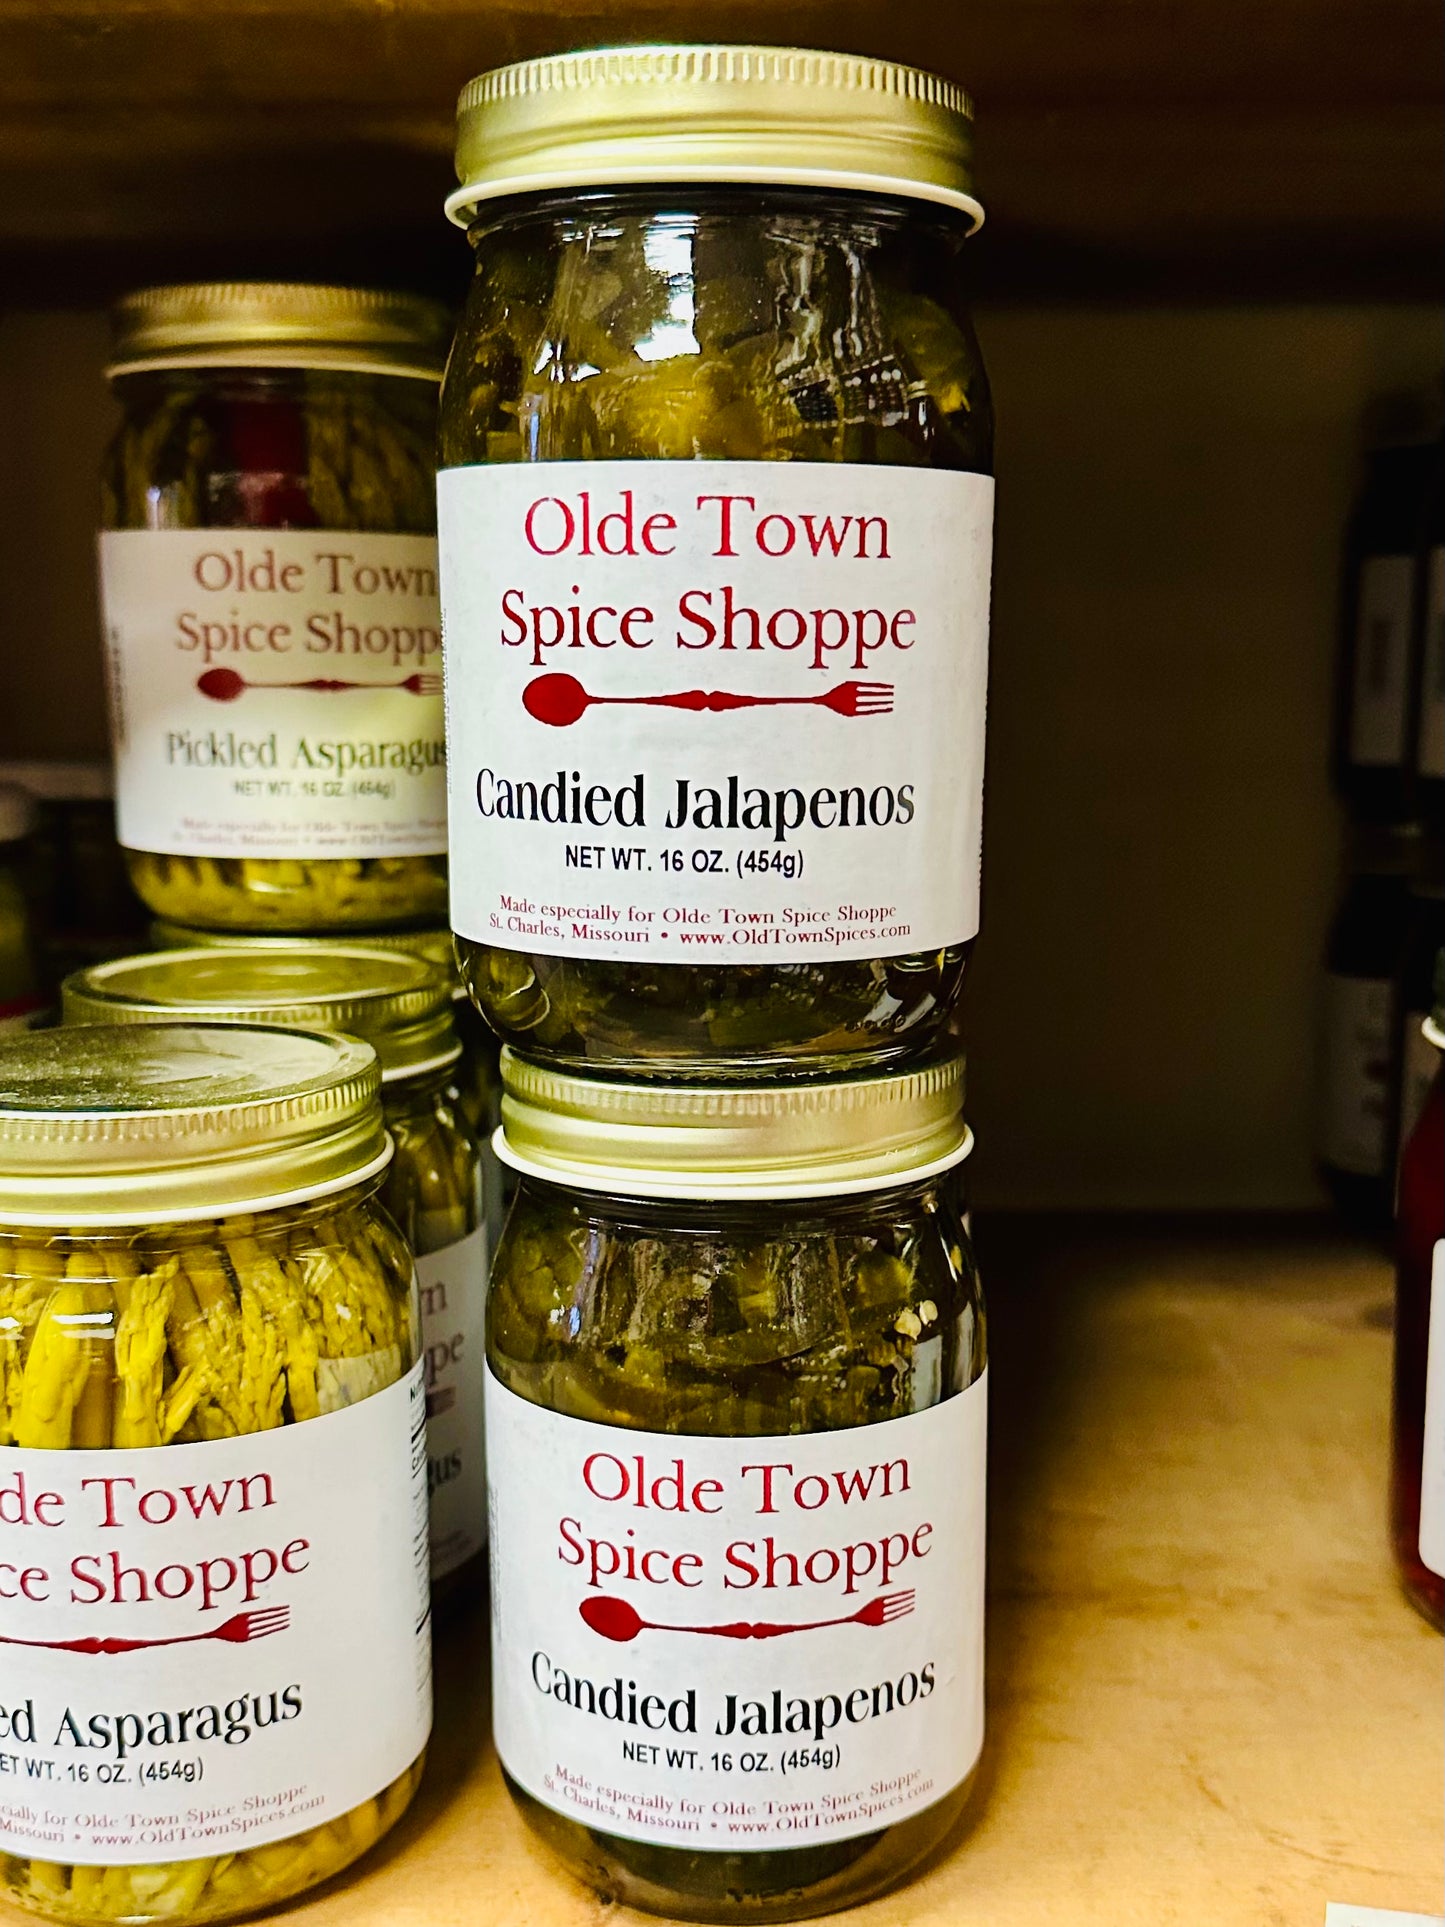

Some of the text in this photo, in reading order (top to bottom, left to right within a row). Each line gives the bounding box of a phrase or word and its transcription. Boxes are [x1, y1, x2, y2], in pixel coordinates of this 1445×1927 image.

[525, 491, 891, 559] Olde Town
[195, 550, 437, 597] Olde Town
[177, 609, 442, 666] Spice Shopp
[501, 585, 916, 669] Spice Shoppe
[167, 730, 277, 768] Pickled
[475, 768, 915, 842] Candied Jalapenos
[565, 846, 804, 878] NET WT. 16 OZ. (454g)
[500, 895, 896, 927] Made especially for Olde Town Spice Shoppe
[508, 917, 565, 940] Charles,
[572, 923, 649, 943] Missouri
[680, 925, 911, 946] www.OldTownSpices.com
[0, 1471, 278, 1529] de Town
[583, 1453, 911, 1514] Olde Town
[70, 1537, 310, 1610] Shoppe
[558, 1517, 703, 1588] Spice
[724, 1522, 934, 1595] Shoppe
[54, 1684, 304, 1759] Asparagus
[532, 1651, 936, 1740] Candied Jalapenos
[0, 1753, 204, 1786] ET WT. 16 OZ. (454g)
[622, 1740, 841, 1775] NET WT. 16 OZ. (454g)
[0, 1784, 308, 1828] cially for Olde Town Spice Shoppe
[556, 1764, 922, 1815] Made especially for Olde Town Spice Shoppe
[564, 1785, 621, 1819] Charles,
[628, 1807, 700, 1831] Missouri
[728, 1778, 934, 1832] www.OldTownSpices.com
[0, 1795, 325, 1845] Missouri www.OldTownSpices.com
